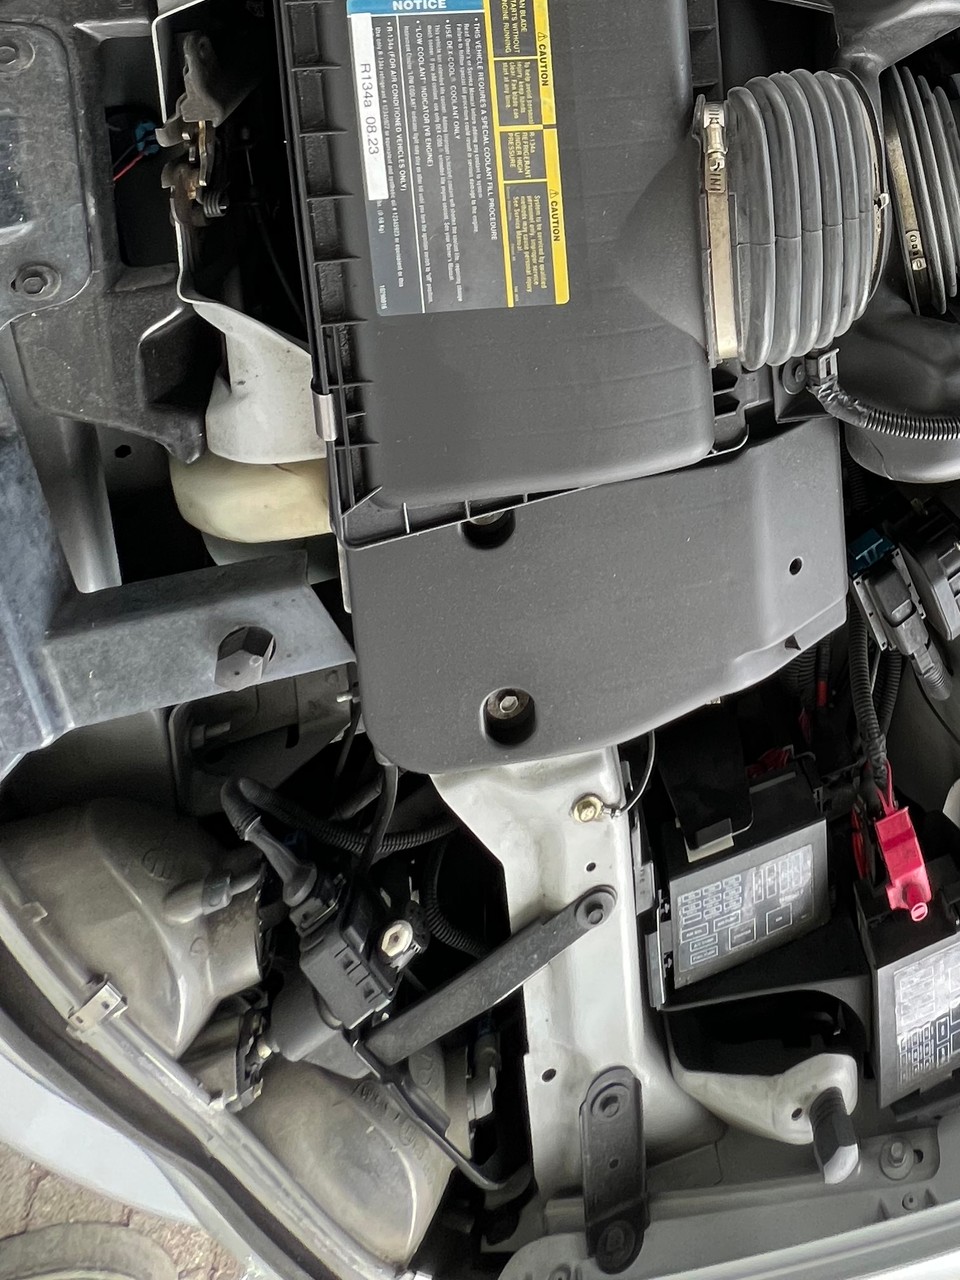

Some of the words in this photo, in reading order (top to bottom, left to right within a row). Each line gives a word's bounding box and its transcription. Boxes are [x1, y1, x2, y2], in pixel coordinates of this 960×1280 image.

[503, 23, 512, 53] RUNNING
[511, 23, 520, 53] WITHOUT
[519, 10, 527, 32] BLADE
[388, 51, 397, 69] (FOR
[475, 40, 484, 70] VEHICLE
[538, 44, 549, 86] CAUTION
[360, 63, 374, 108] R134a
[390, 70, 398, 82] AIR
[478, 72, 487, 108] REQUIRES
[391, 84, 402, 133] CONDITIONED
[420, 86, 430, 124] INDICATOR
[450, 85, 459, 119] COOLANT
[365, 116, 379, 155] 08.23
[481, 116, 490, 145] SPECIAL
[514, 132, 522, 156] UNDER
[395, 134, 405, 169] VEHICLES
[424, 138, 433, 167] ENGINE)
[484, 147, 492, 181] COOLANT
[507, 133, 516, 168] PRESSURE
[516, 157, 524, 173] HIGH
[521, 132, 531, 178] REFRIGERANT
[398, 170, 406, 191] ONLY)
[488, 198, 497, 241] PROCEDURE
[551, 200, 561, 242] CAUTION
